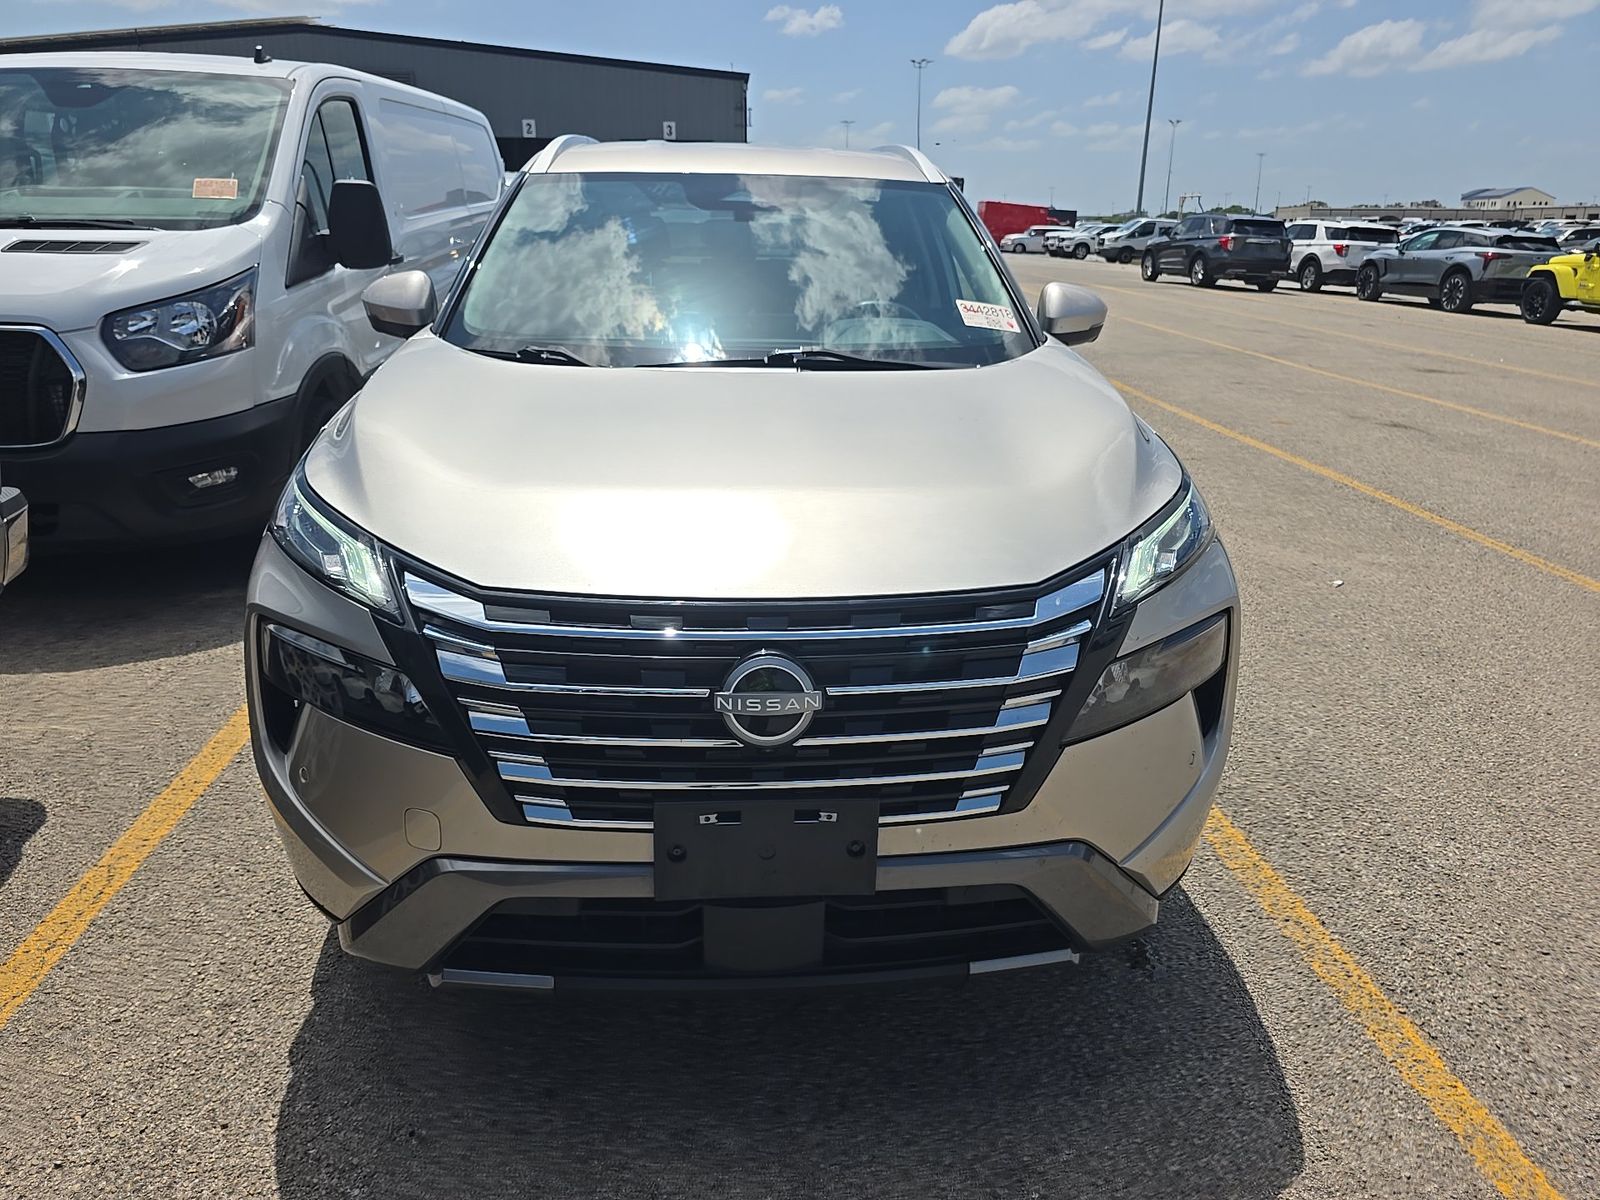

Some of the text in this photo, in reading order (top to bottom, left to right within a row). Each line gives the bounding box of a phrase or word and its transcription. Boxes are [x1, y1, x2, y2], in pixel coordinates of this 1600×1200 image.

[525, 122, 533, 135] 2
[666, 124, 673, 136] 3
[717, 695, 819, 711] NISSAN
